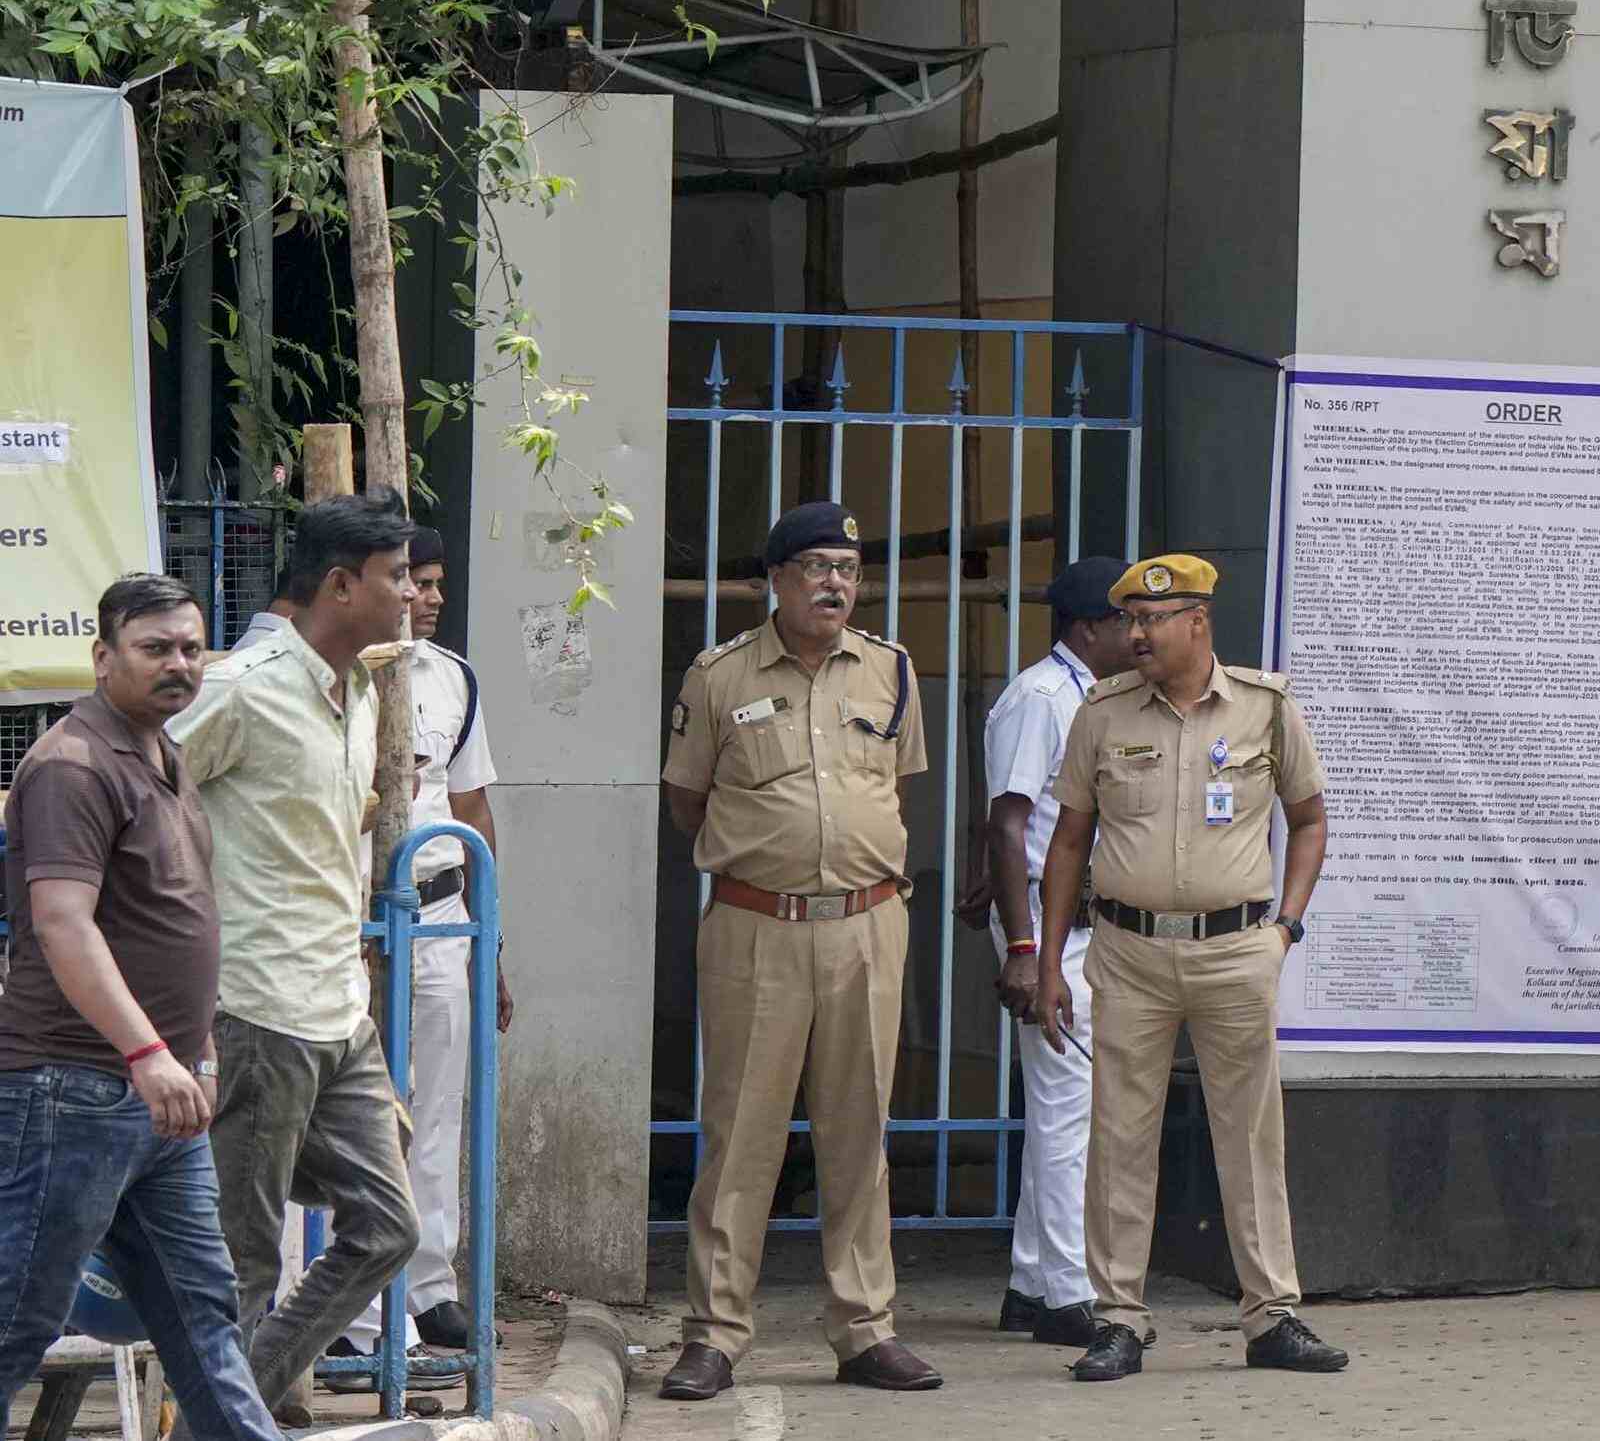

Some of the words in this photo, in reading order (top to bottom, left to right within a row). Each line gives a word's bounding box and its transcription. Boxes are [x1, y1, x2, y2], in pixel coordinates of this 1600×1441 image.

[1304, 398, 1323, 410] No.
[1327, 399, 1348, 411] 356
[1351, 400, 1379, 412] /RPT
[1485, 402, 1562, 422] ORDER
[0, 526, 48, 547] ers
[1338, 832, 1397, 840] contravening
[1444, 833, 1465, 841] shall
[1481, 834, 1504, 842] liable
[1506, 834, 1519, 842] for
[1520, 836, 1574, 844] prosecution
